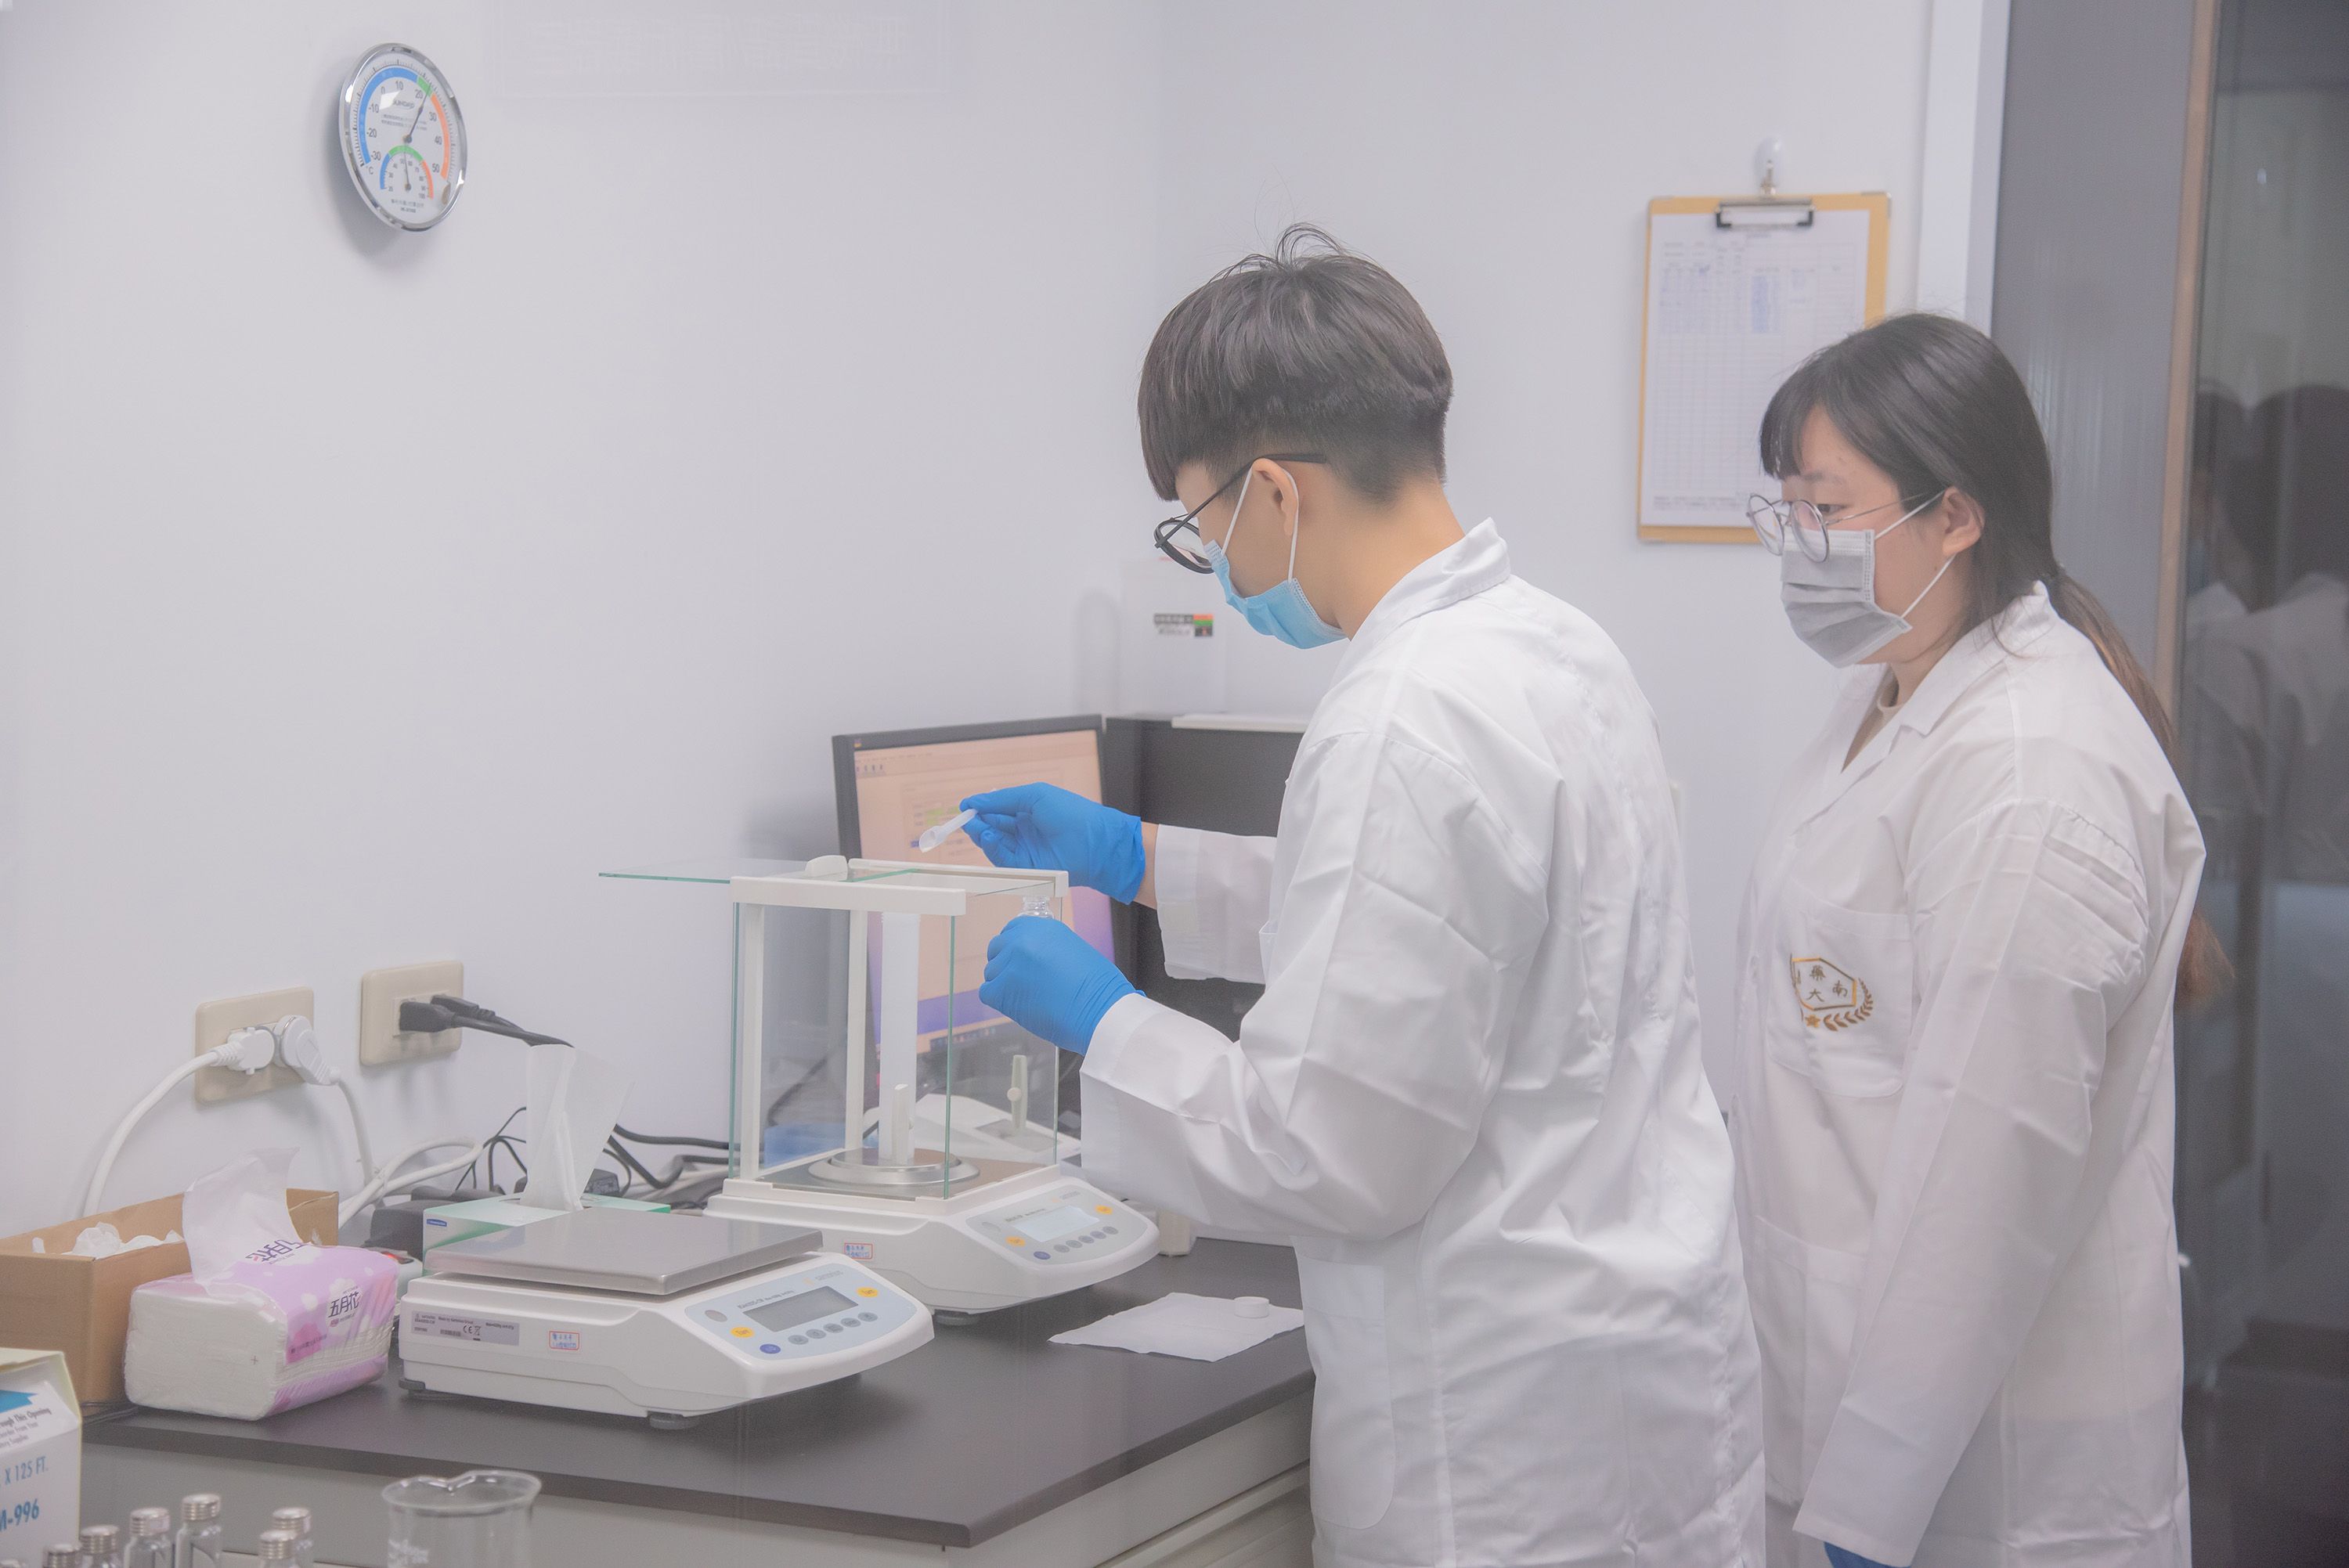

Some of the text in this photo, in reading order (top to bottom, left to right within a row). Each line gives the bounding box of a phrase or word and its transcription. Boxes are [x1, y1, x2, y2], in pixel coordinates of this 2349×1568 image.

[395, 81, 403, 91] 10
[415, 89, 423, 99] 20
[369, 103, 379, 113] -10
[429, 111, 437, 122] 30
[366, 128, 377, 138] -20
[435, 136, 442, 145] 40
[371, 150, 381, 160] -30
[432, 163, 439, 173] 50
[1806, 989, 1824, 1002] 大
[328, 1290, 360, 1318] 五月花
[27, 1408, 52, 1419] Opening
[5, 1456, 49, 1485] X 125 FT.
